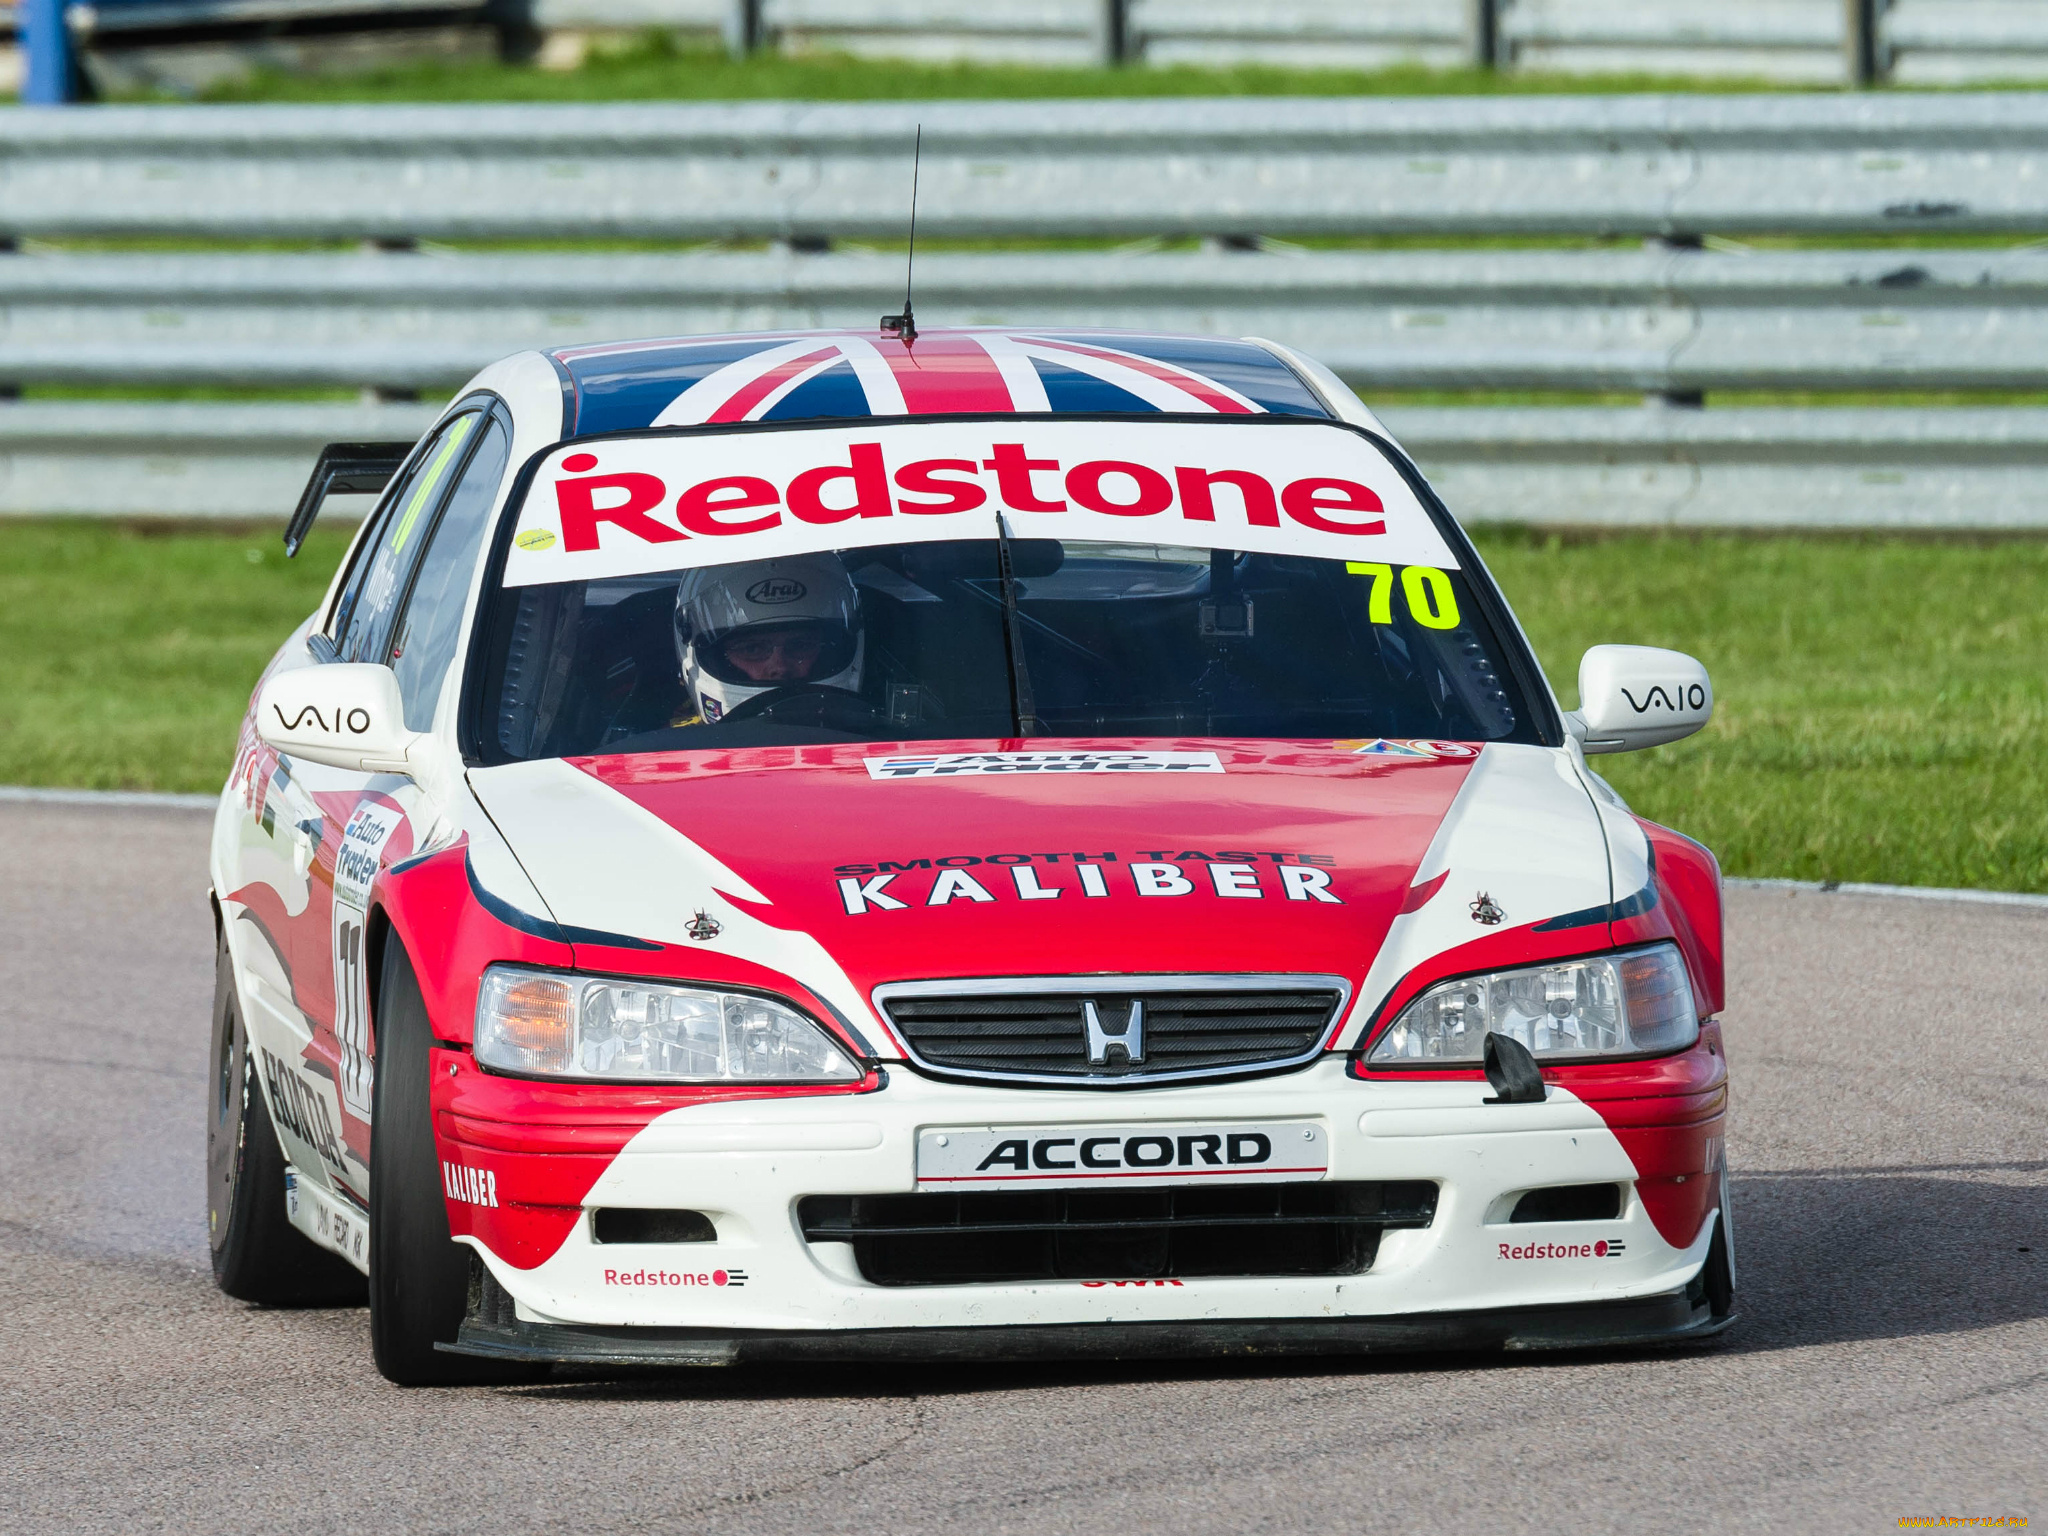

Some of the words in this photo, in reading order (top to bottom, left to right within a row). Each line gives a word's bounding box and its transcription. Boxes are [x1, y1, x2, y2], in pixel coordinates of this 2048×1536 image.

[752, 581, 798, 596] Arai
[1346, 562, 1461, 630] 70
[1621, 683, 1705, 713] VAIO
[273, 703, 370, 734] VAIO
[880, 762, 1213, 777] Trader
[938, 754, 1149, 763] Auto
[351, 813, 386, 845] Auto
[833, 851, 1120, 877] SMOOTH
[1136, 849, 1336, 867] TASTE
[836, 863, 1346, 917] KALIBER
[261, 1046, 349, 1175] HONDA
[974, 1132, 1272, 1171] ACCORD
[443, 1160, 499, 1208] KALIBER
[1498, 1242, 1591, 1260] Redstone
[603, 1267, 710, 1288] Redstone
